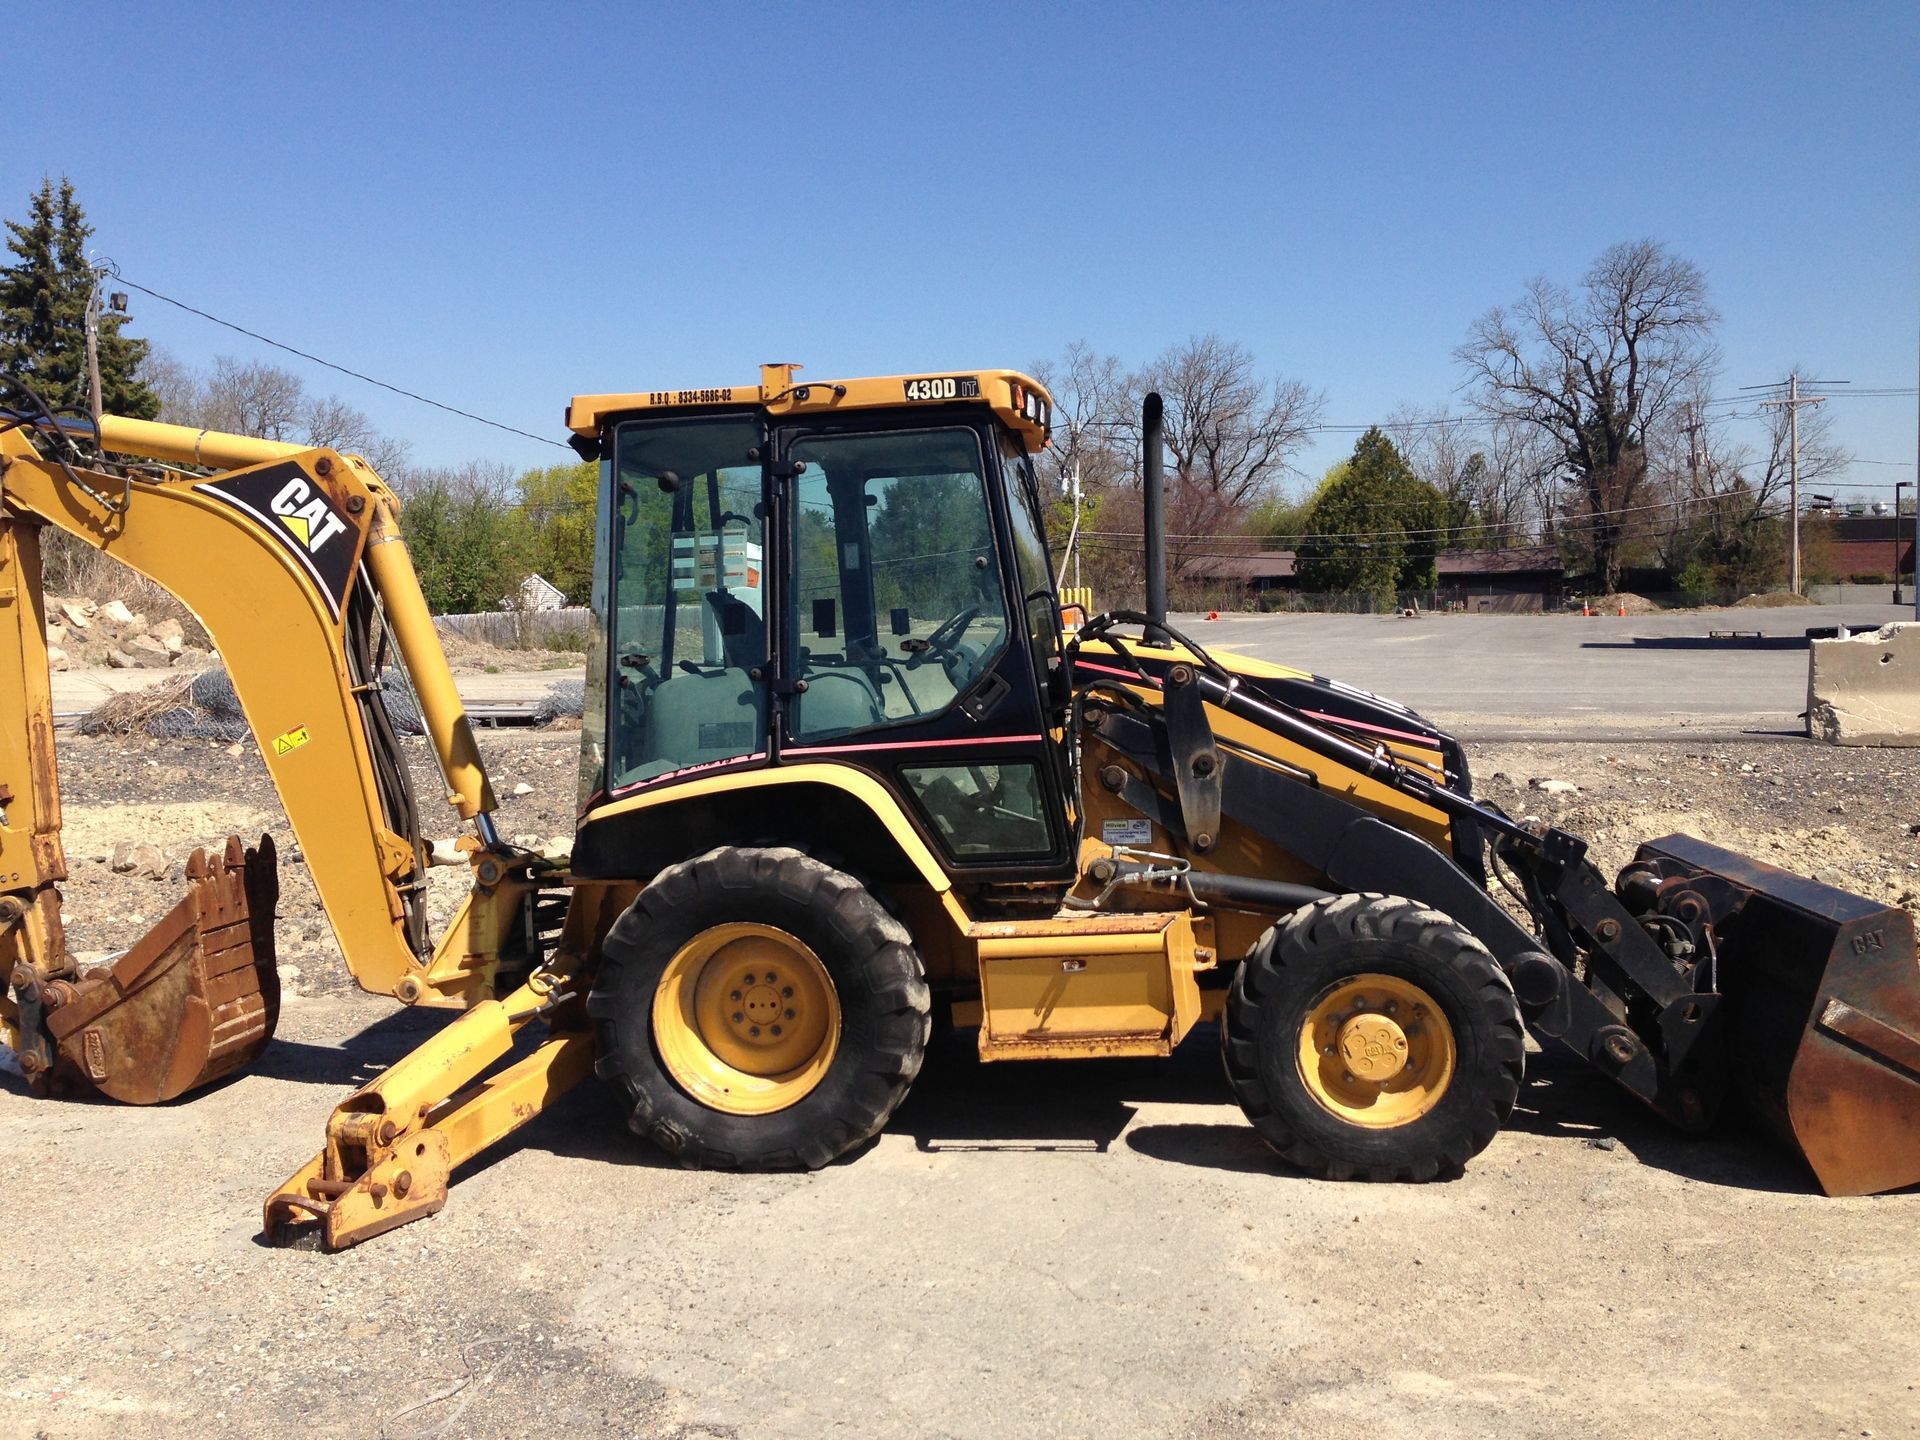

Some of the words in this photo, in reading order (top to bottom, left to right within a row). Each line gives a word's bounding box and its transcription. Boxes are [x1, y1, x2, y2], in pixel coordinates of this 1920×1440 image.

[908, 378, 956, 400] 430D
[962, 381, 977, 397] IT
[270, 477, 347, 554] CAT
[1853, 929, 1886, 954] CAT
